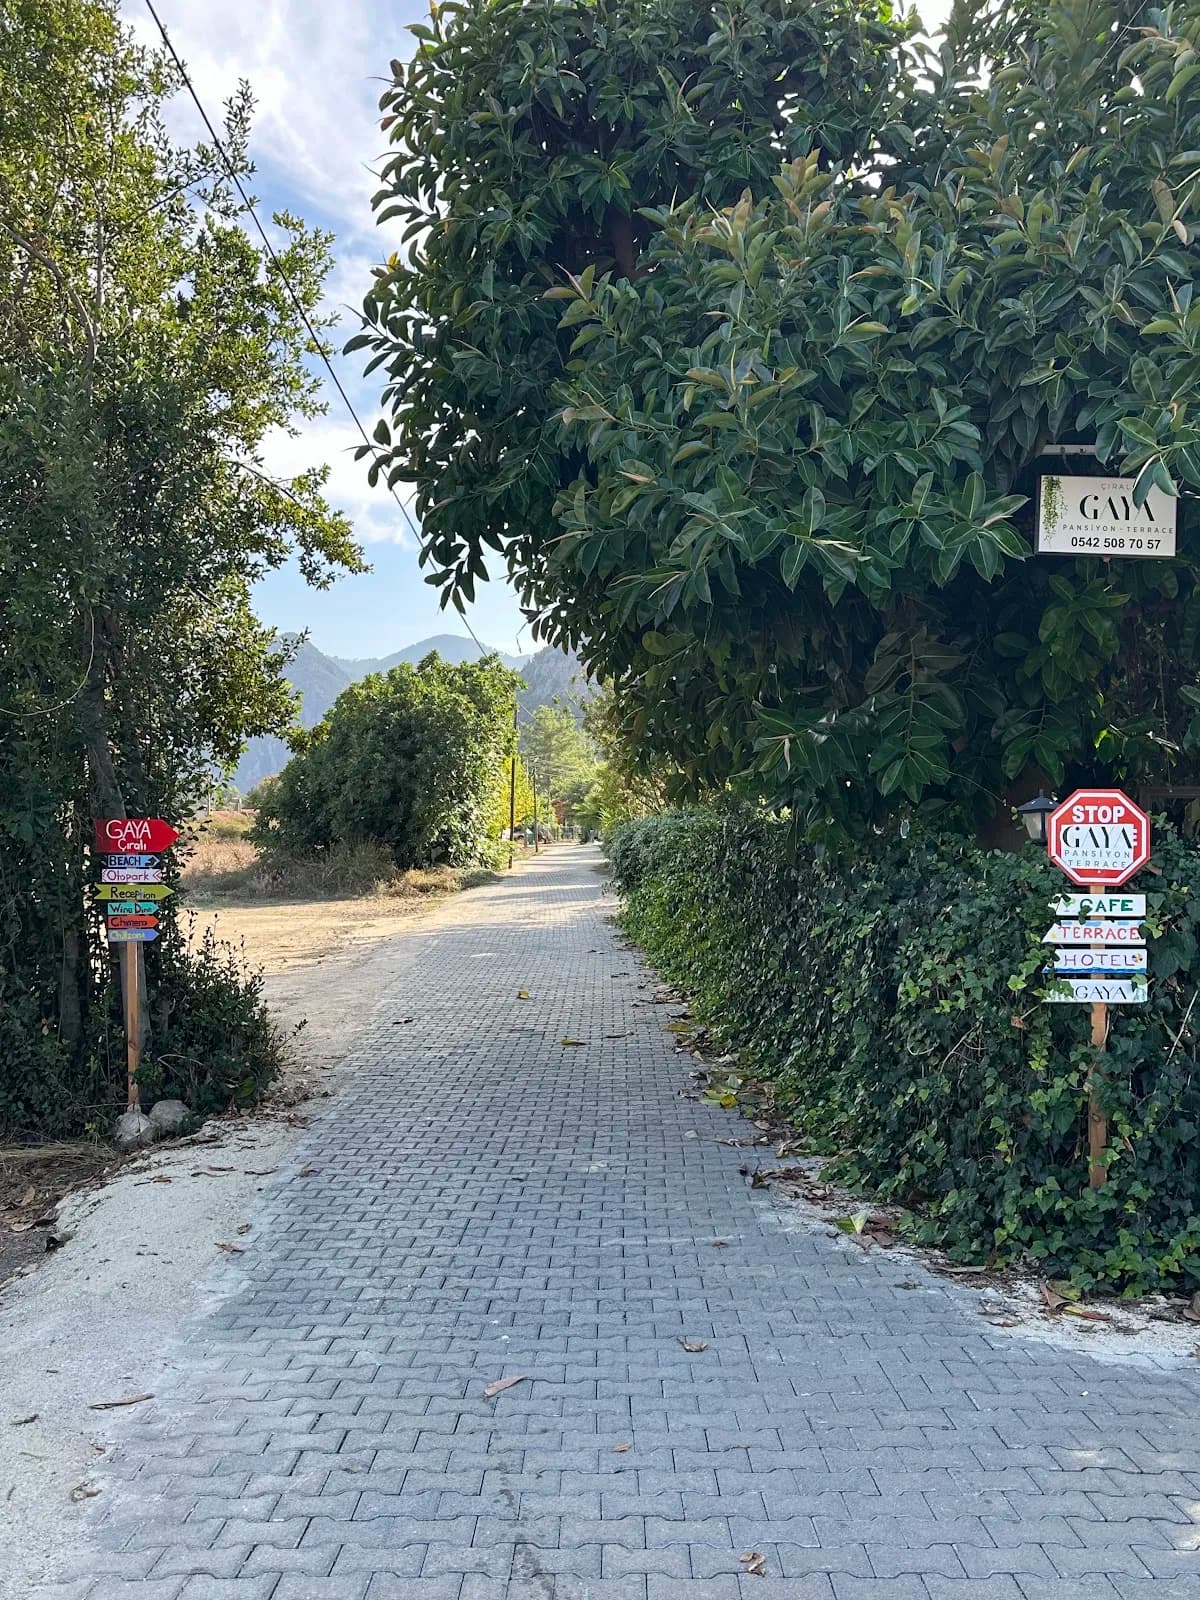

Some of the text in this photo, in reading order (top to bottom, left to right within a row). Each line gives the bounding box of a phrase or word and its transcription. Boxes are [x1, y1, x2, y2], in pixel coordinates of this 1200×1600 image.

[1080, 494, 1155, 521] GAYA
[1127, 525, 1174, 534] TERRACE
[1071, 536, 1161, 550] 0542 508 70 57
[1072, 805, 1125, 823] STOP
[106, 819, 151, 840] GAYA
[1062, 826, 1132, 849] GAYA
[109, 855, 141, 866] BEACH
[1068, 859, 1127, 868] TERRACE
[106, 870, 149, 881] Otopark
[1080, 898, 1133, 912] CAFE
[1058, 926, 1140, 940] TERRACE
[1063, 954, 1135, 967] HOTEL
[1075, 985, 1127, 1000] GAYA
